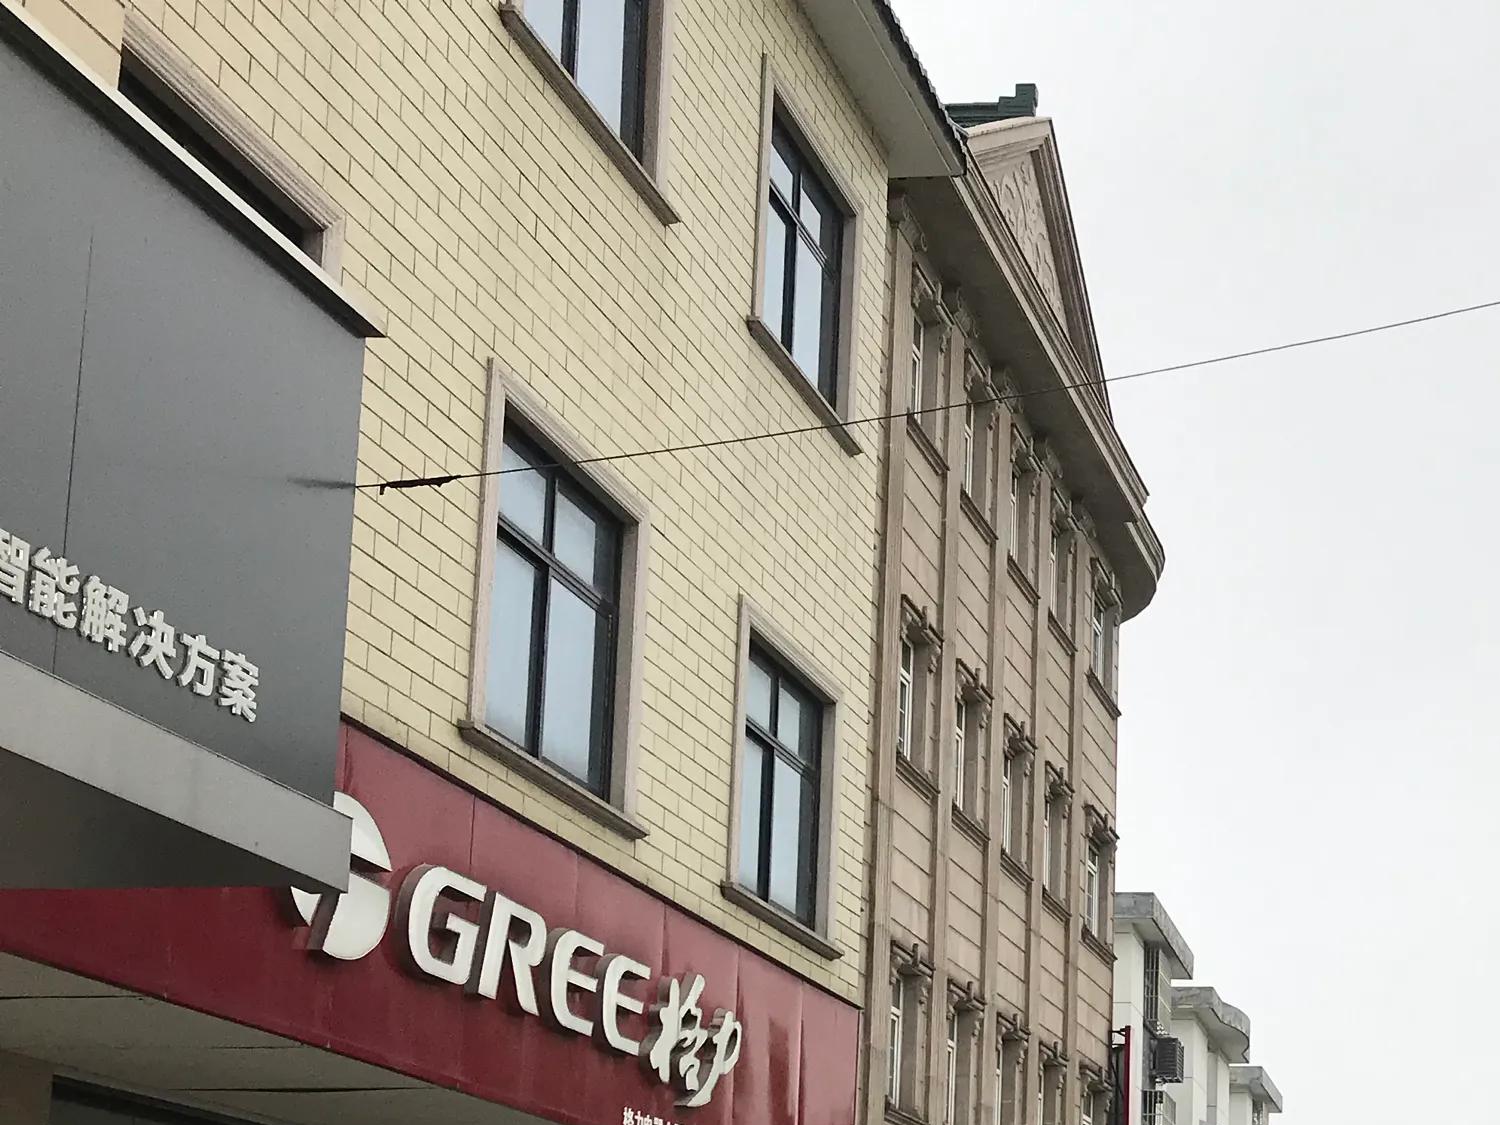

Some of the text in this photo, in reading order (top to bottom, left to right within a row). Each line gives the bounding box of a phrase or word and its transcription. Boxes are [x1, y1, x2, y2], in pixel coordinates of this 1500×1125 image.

[0, 526, 260, 724] 智能解决方案
[398, 863, 652, 1056] GREE
